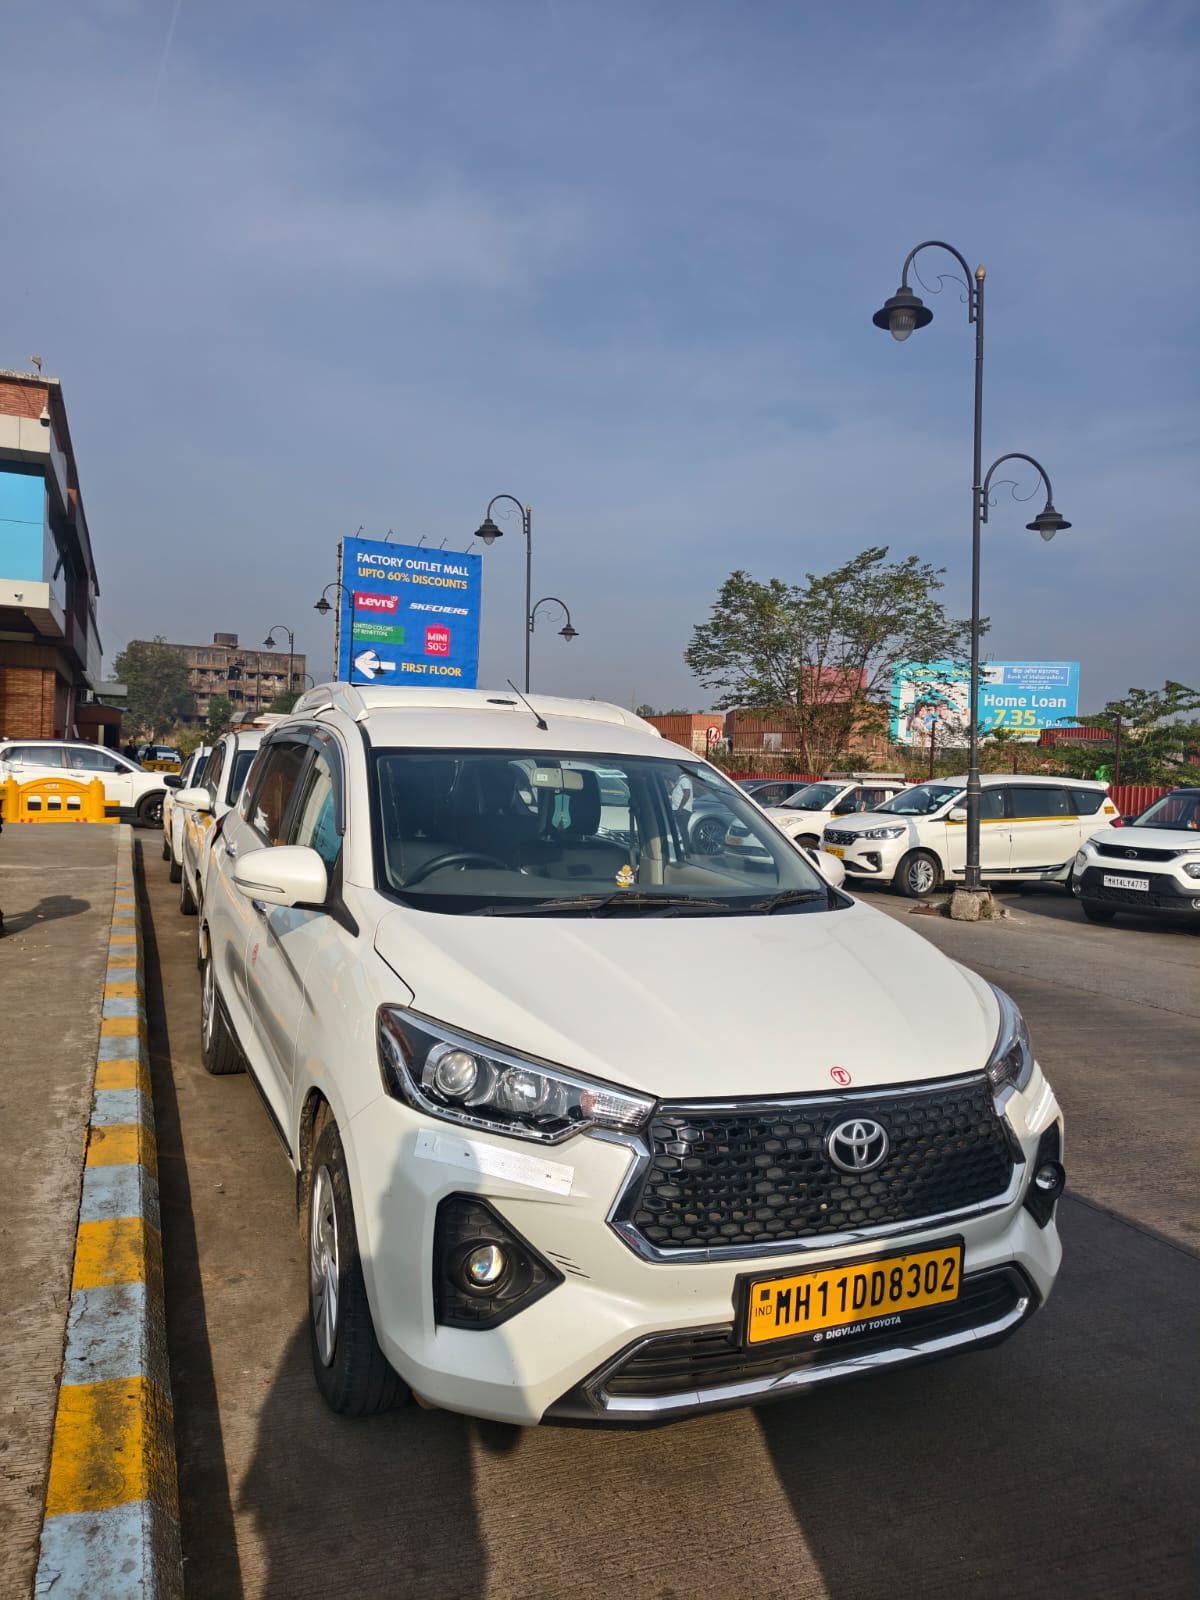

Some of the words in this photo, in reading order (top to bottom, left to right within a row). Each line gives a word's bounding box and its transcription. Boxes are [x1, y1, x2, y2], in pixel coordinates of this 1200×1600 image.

[357, 553, 402, 567] FACTORY
[406, 560, 441, 572] OUTLET
[444, 565, 469, 576] MALL
[358, 567, 385, 579] UPTO
[388, 571, 410, 583] 60%
[412, 574, 467, 590] DISCOUNTS
[409, 602, 469, 616] SKECHERS
[427, 633, 447, 642] MINI
[401, 663, 426, 674] FIRST
[429, 664, 461, 676] FLOOR
[984, 694, 1027, 707] Home
[1031, 695, 1066, 708] Loan
[755, 1304, 773, 1317] IND
[775, 1257, 956, 1327] MH11DD8302
[825, 1323, 867, 1340] DIGVIJAY
[869, 1316, 901, 1331] TOYOTA
